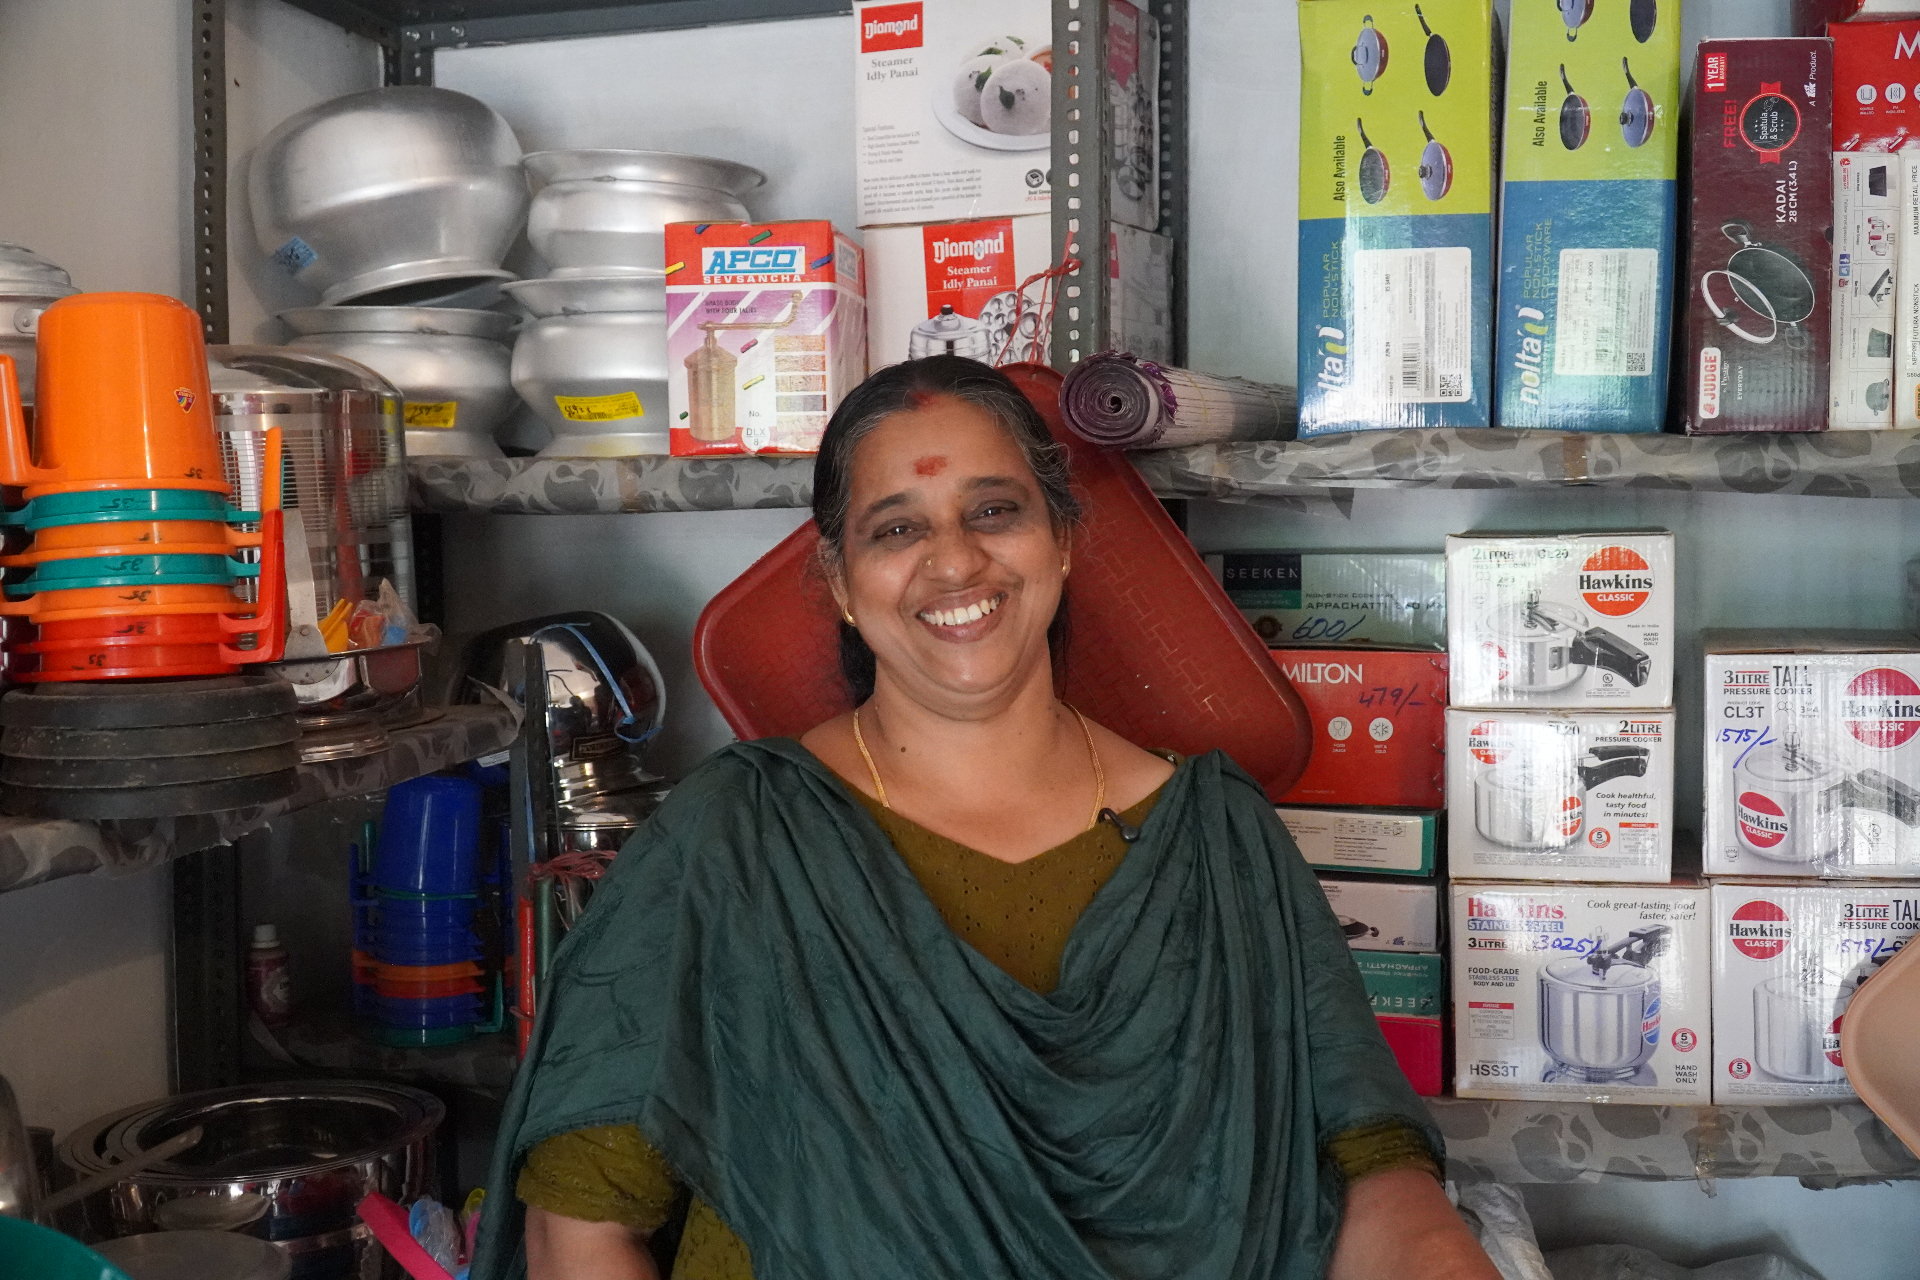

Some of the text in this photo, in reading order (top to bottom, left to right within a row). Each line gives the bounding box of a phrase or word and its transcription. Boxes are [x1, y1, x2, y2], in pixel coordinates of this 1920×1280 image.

[864, 13, 918, 39] Diamond
[871, 57, 913, 68] Steamer
[1707, 56, 1719, 80] YEAR
[866, 67, 918, 82] Idly Panai
[1707, 82, 1725, 90] 1
[1532, 80, 1548, 147] Also Available
[1724, 100, 1737, 148] FREE!
[1760, 112, 1769, 140] Spatula
[1769, 111, 1778, 133] Scrub
[1333, 135, 1346, 202] Also Available
[1776, 180, 1786, 223] KADAI
[1789, 192, 1798, 209] CM
[1789, 210, 1798, 223] 28
[933, 232, 1004, 263] Diamond
[704, 249, 797, 275] APCO
[1524, 234, 1533, 299] POPULAR
[1532, 222, 1543, 299] NON-STICK
[1541, 218, 1552, 300] COOKWARE
[947, 265, 992, 276] Steamer
[703, 275, 802, 285] SEVSANCHA
[943, 276, 998, 291] Idly Panai
[1331, 241, 1339, 318] NON-STICK
[1704, 356, 1717, 400] JUDGE
[746, 428, 765, 436] DLX
[1579, 573, 1653, 590] Hawkins
[1597, 594, 1634, 602] CLASSIC
[1282, 662, 1363, 685] MILTON
[1724, 670, 1770, 684] 3 LITRE
[1773, 666, 1812, 687] TALL
[1724, 706, 1765, 719] CL3T
[1619, 720, 1662, 733] 2 LITRE
[1605, 802, 1625, 810] tasty
[1738, 805, 1789, 833] Hawkins
[1745, 825, 1772, 840] CLASSIC
[1587, 899, 1696, 912] Cook great-tasting food
[1844, 903, 1890, 918] 3 LITRE
[1639, 911, 1667, 921] faster,
[1729, 924, 1792, 938] Hawkins
[1468, 937, 1508, 949] 3 LITRE
[1745, 940, 1777, 948] CLASSIC
[1468, 967, 1520, 975] FOOD-GRADE
[1470, 1064, 1520, 1078] HSS3T
[1736, 1062, 1743, 1070] 5
